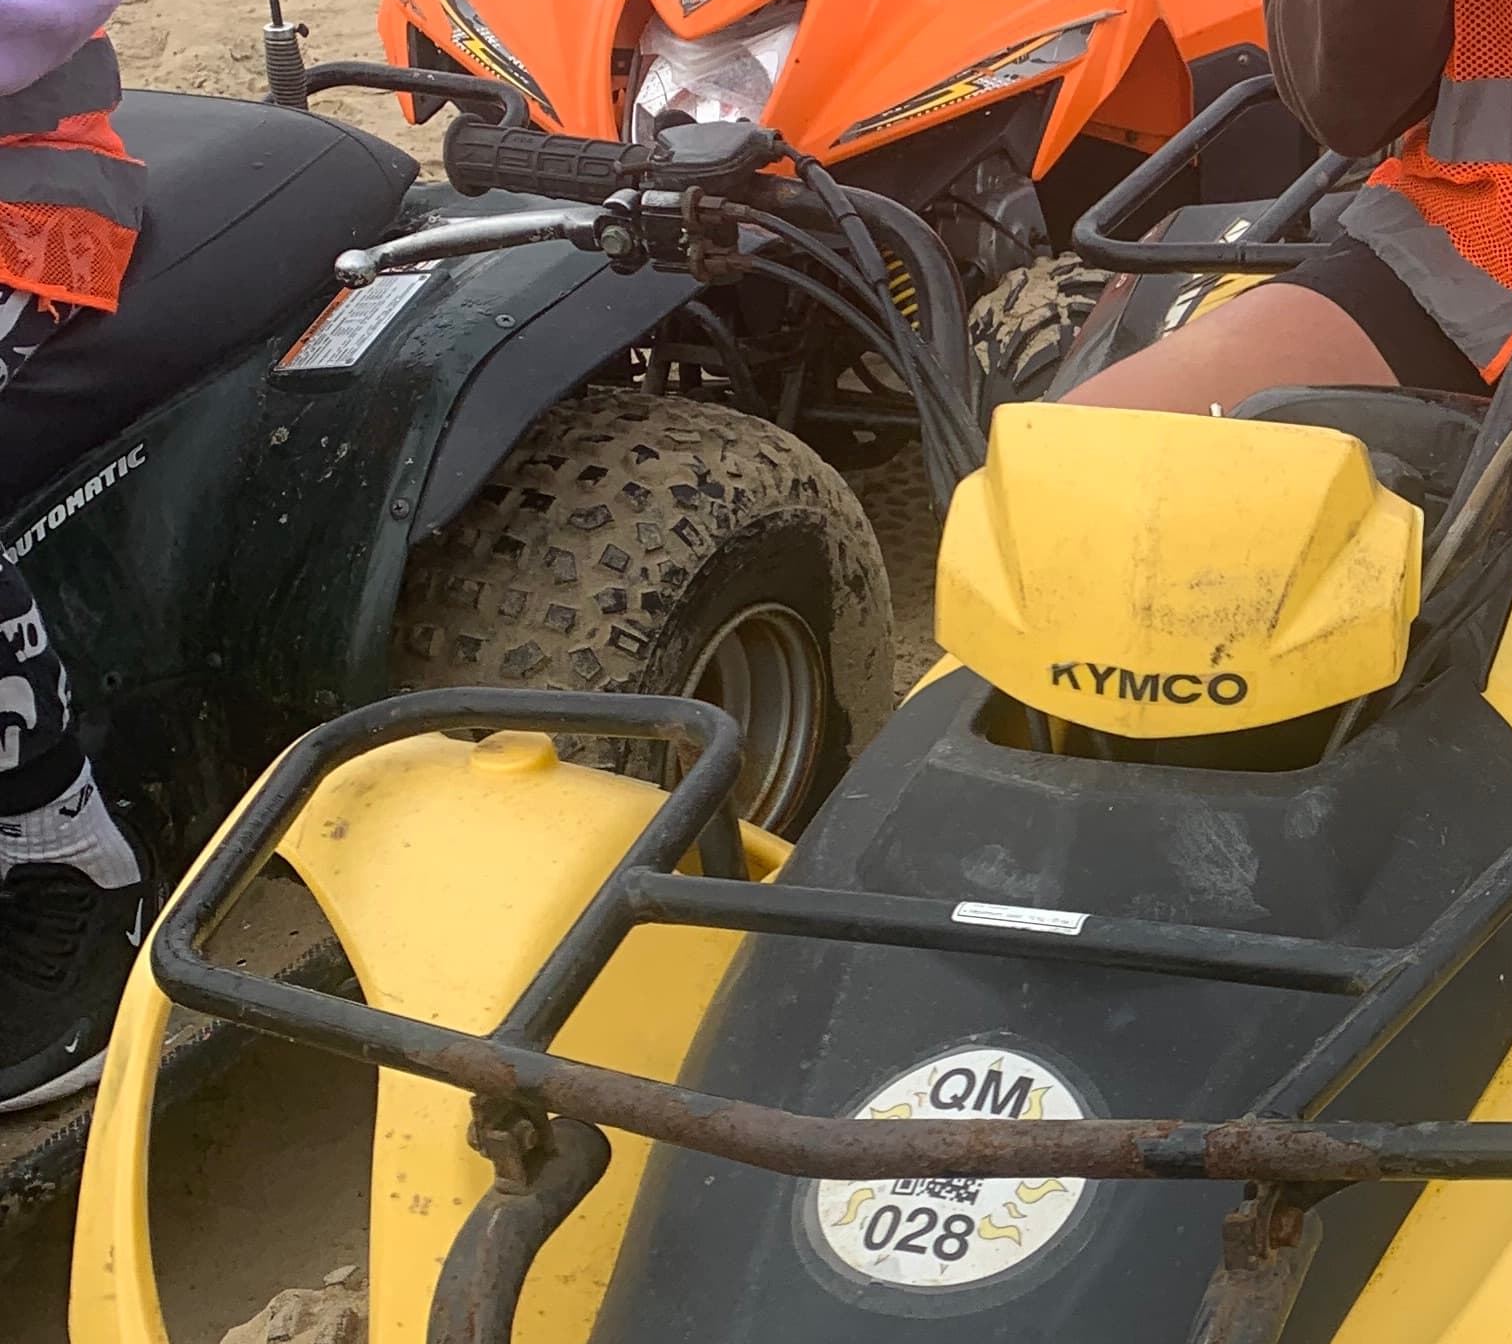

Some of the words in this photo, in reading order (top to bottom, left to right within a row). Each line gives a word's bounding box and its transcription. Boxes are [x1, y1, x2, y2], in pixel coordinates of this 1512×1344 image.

[1049, 661, 1249, 706] KYMCO
[930, 1067, 1035, 1119] QM
[863, 1204, 976, 1262] 028
